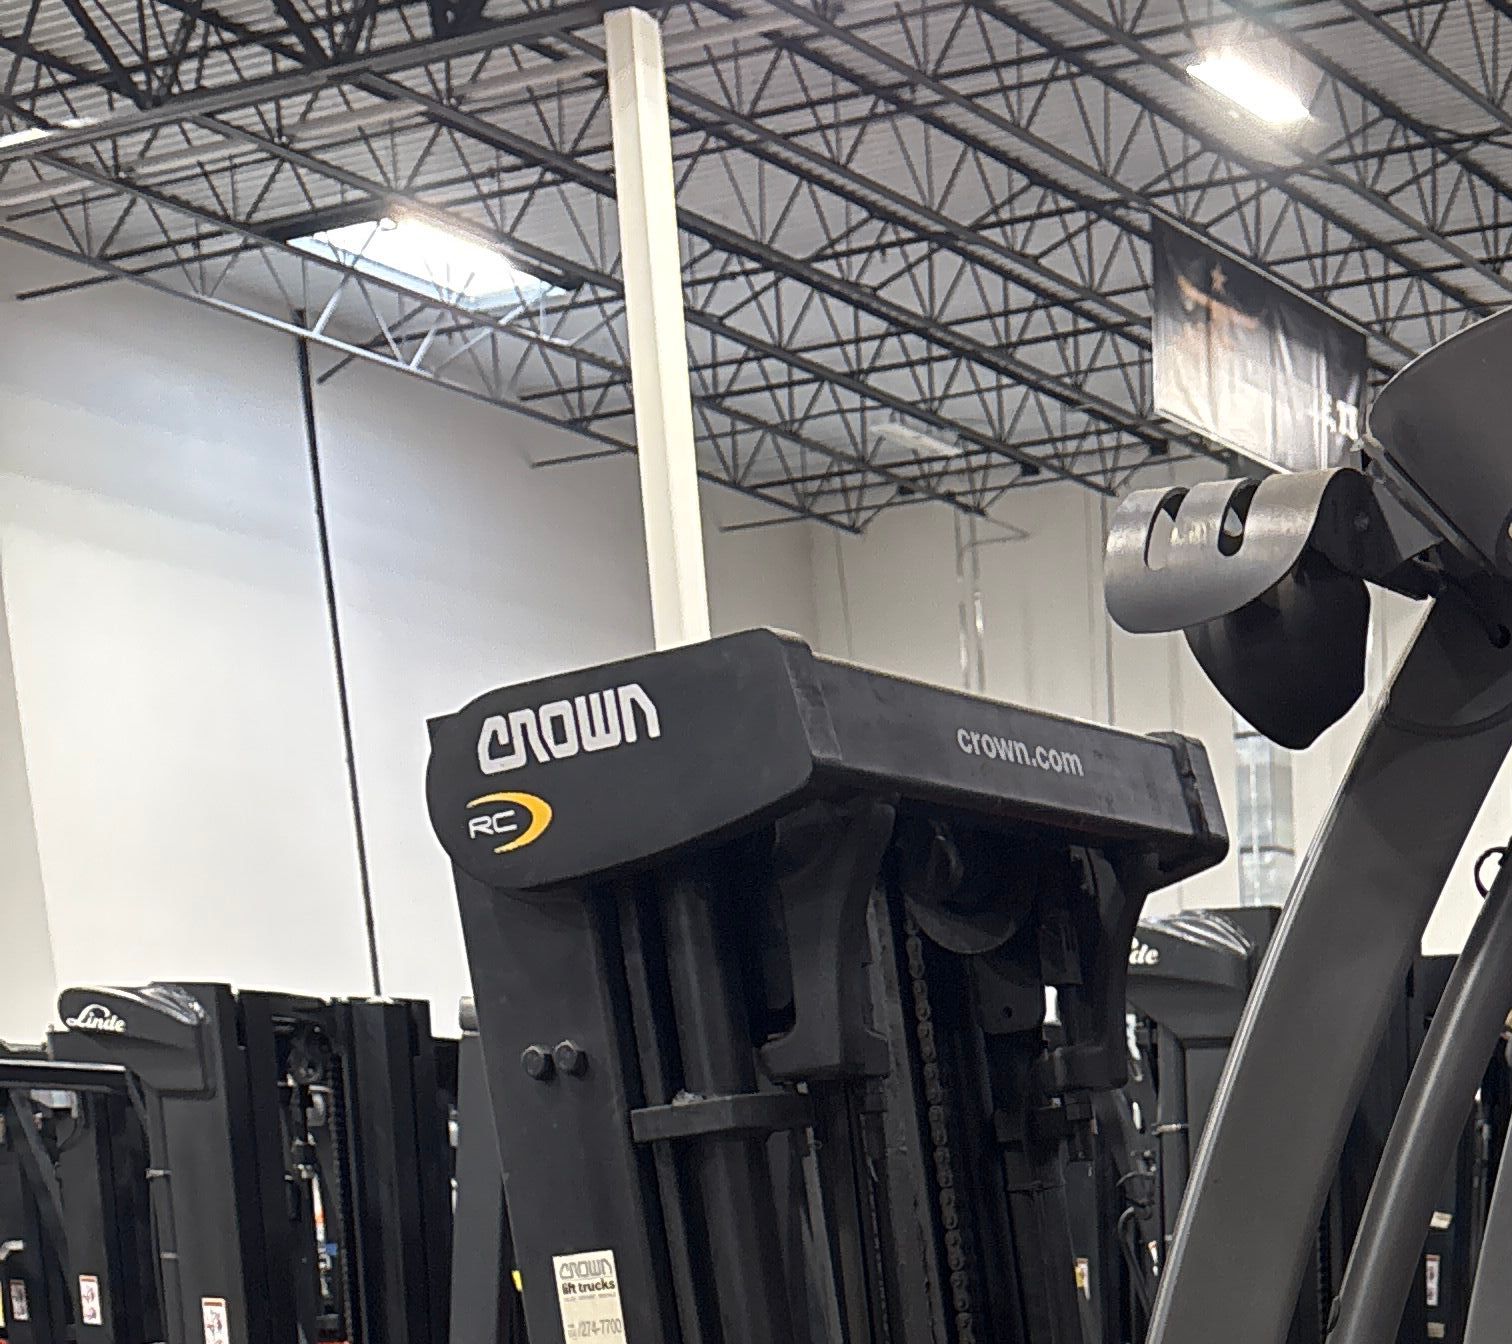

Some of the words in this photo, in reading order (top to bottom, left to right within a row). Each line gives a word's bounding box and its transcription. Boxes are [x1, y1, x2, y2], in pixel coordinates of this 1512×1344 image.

[478, 683, 661, 776] CROWN
[956, 727, 1085, 777] crown.com
[468, 809, 518, 840] RC
[65, 1003, 126, 1032] Linde
[559, 1257, 614, 1281] CROWN
[578, 1277, 616, 1292] trucks
